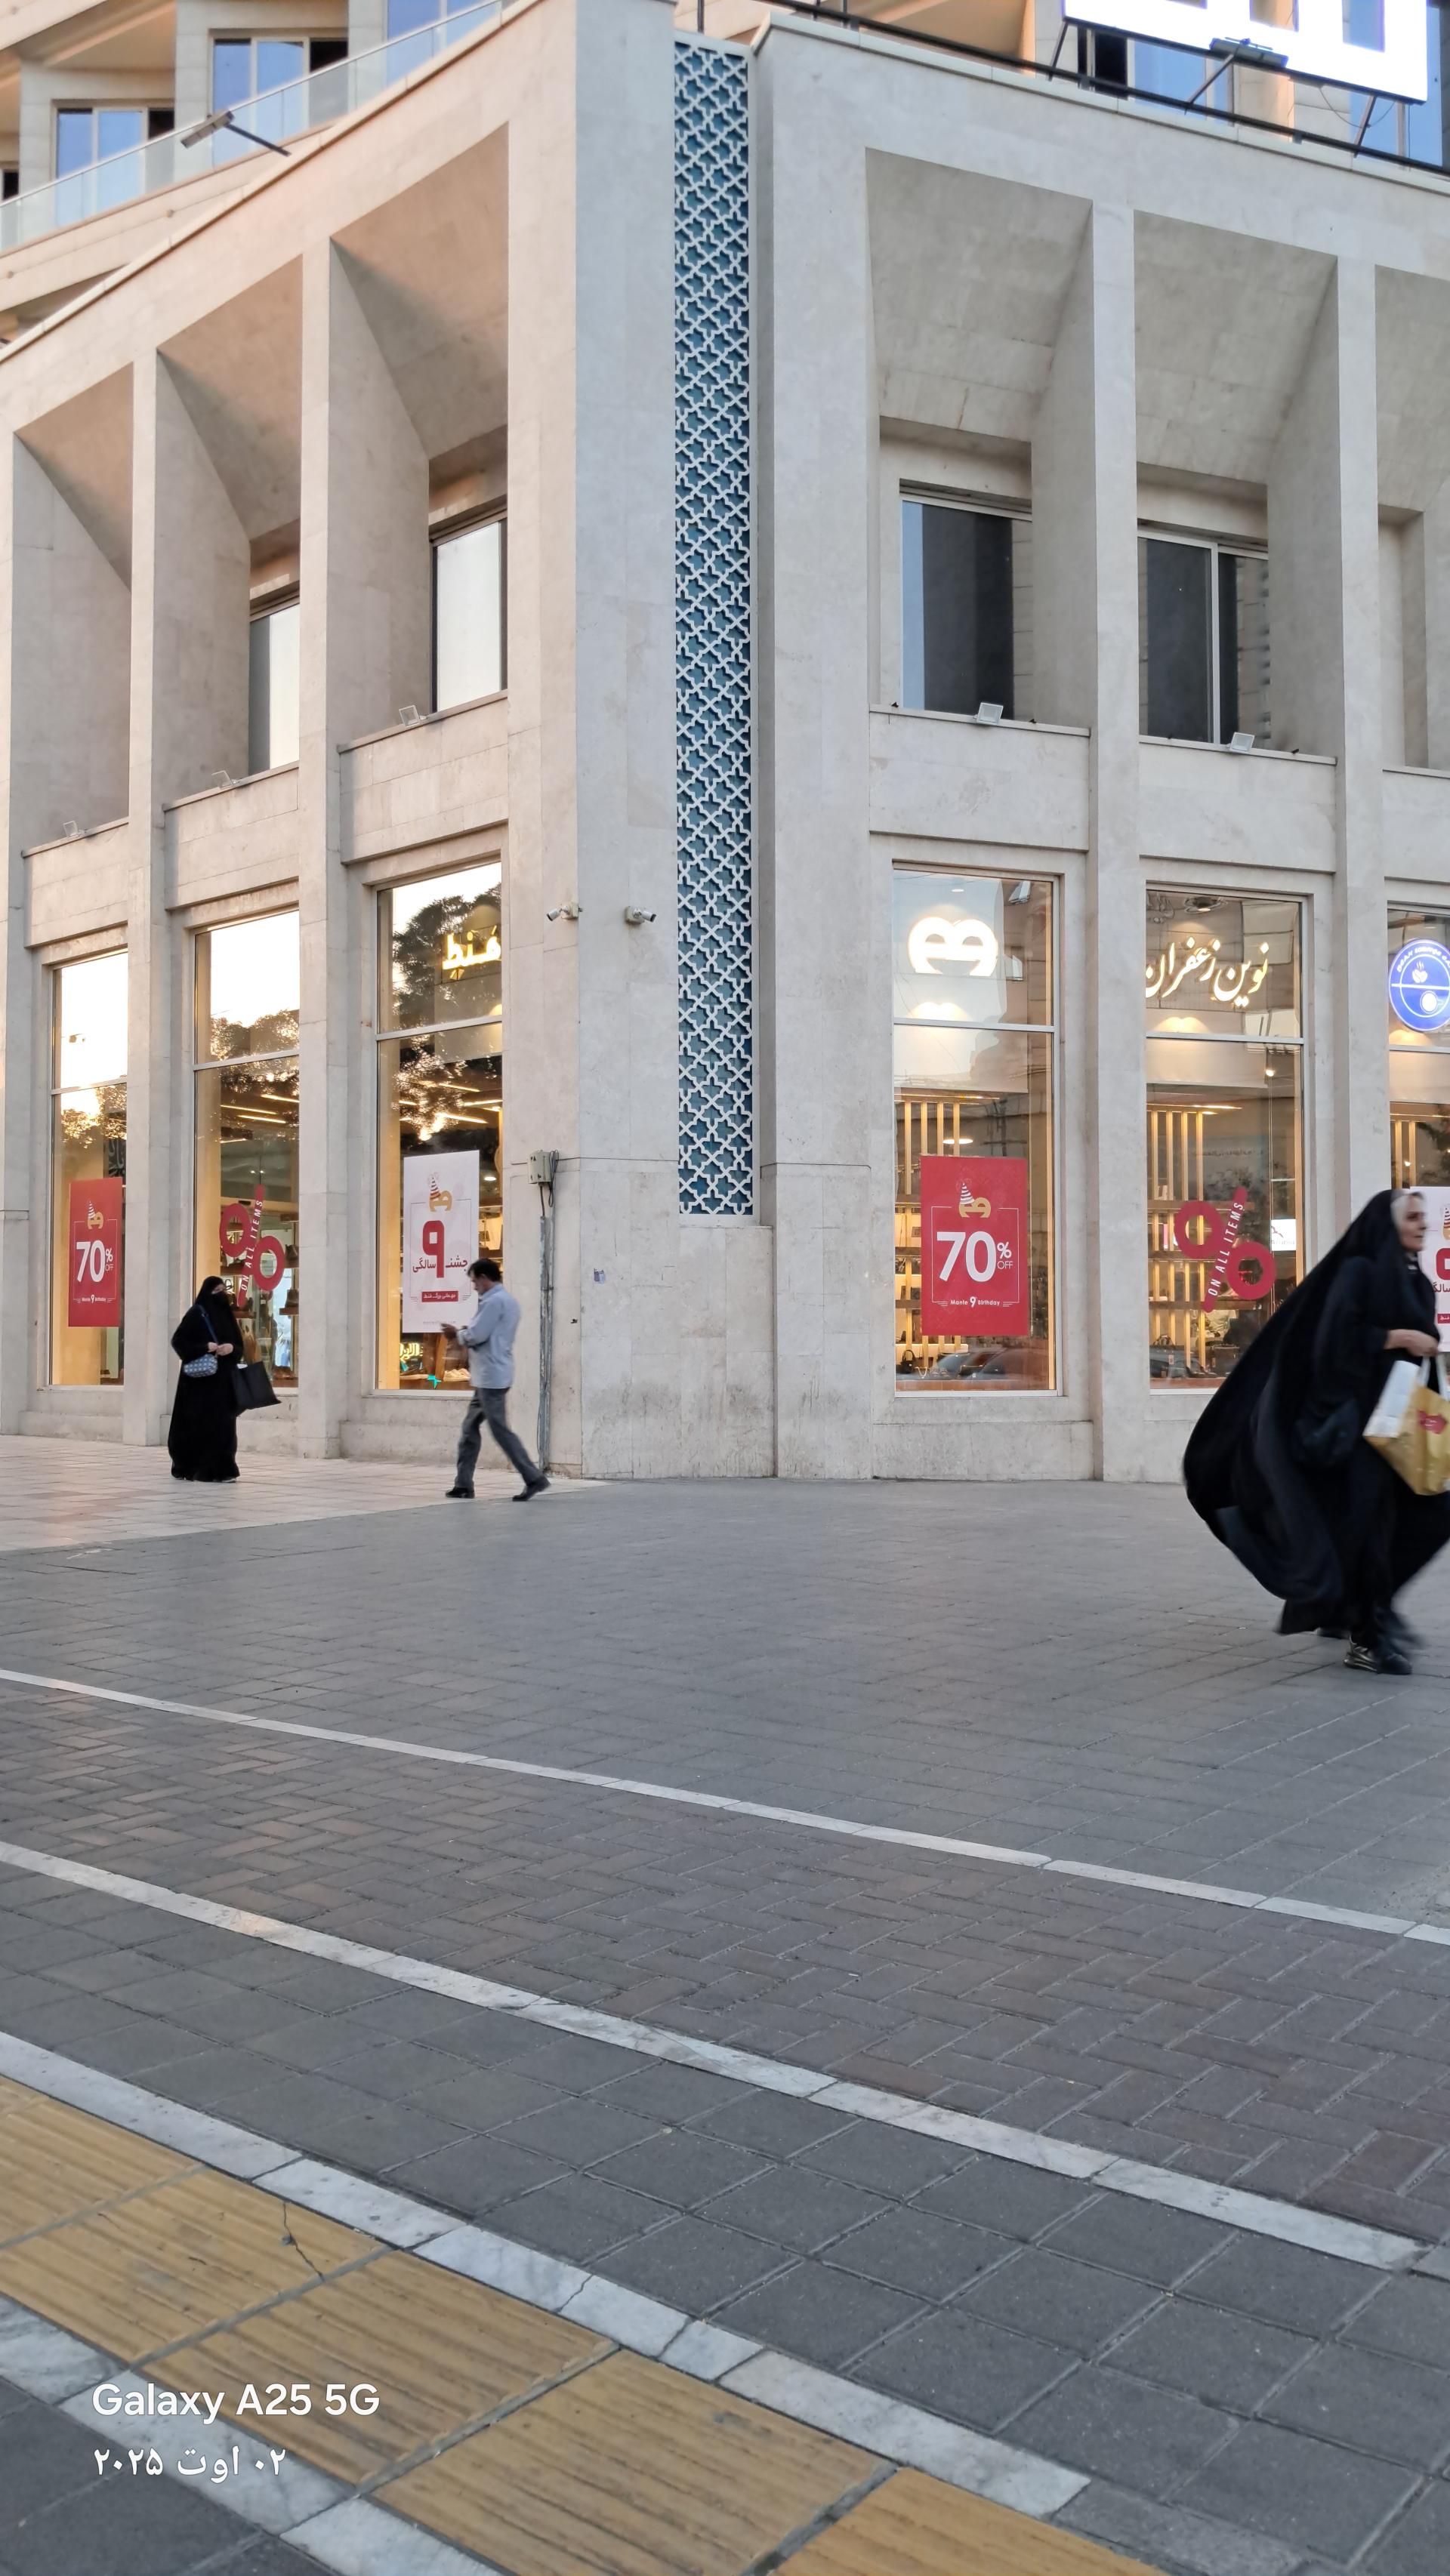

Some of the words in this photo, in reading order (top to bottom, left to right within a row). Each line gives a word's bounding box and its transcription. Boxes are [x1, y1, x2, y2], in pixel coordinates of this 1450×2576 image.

[1146, 937, 1221, 998] زعفران
[1214, 942, 1270, 1006] نوین
[250, 1200, 263, 1239] ITEMS
[245, 1246, 255, 1268] ALL
[1208, 1278, 1221, 1296] ON
[1215, 1250, 1230, 1273] ALL
[1223, 1203, 1243, 1243] ITEMS
[105, 1263, 114, 1271] OFF
[412, 1257, 436, 1272] سالگی
[997, 1260, 1013, 1269] OFF
[241, 1275, 250, 1291] ON
[977, 1298, 1000, 1307] Birthday
